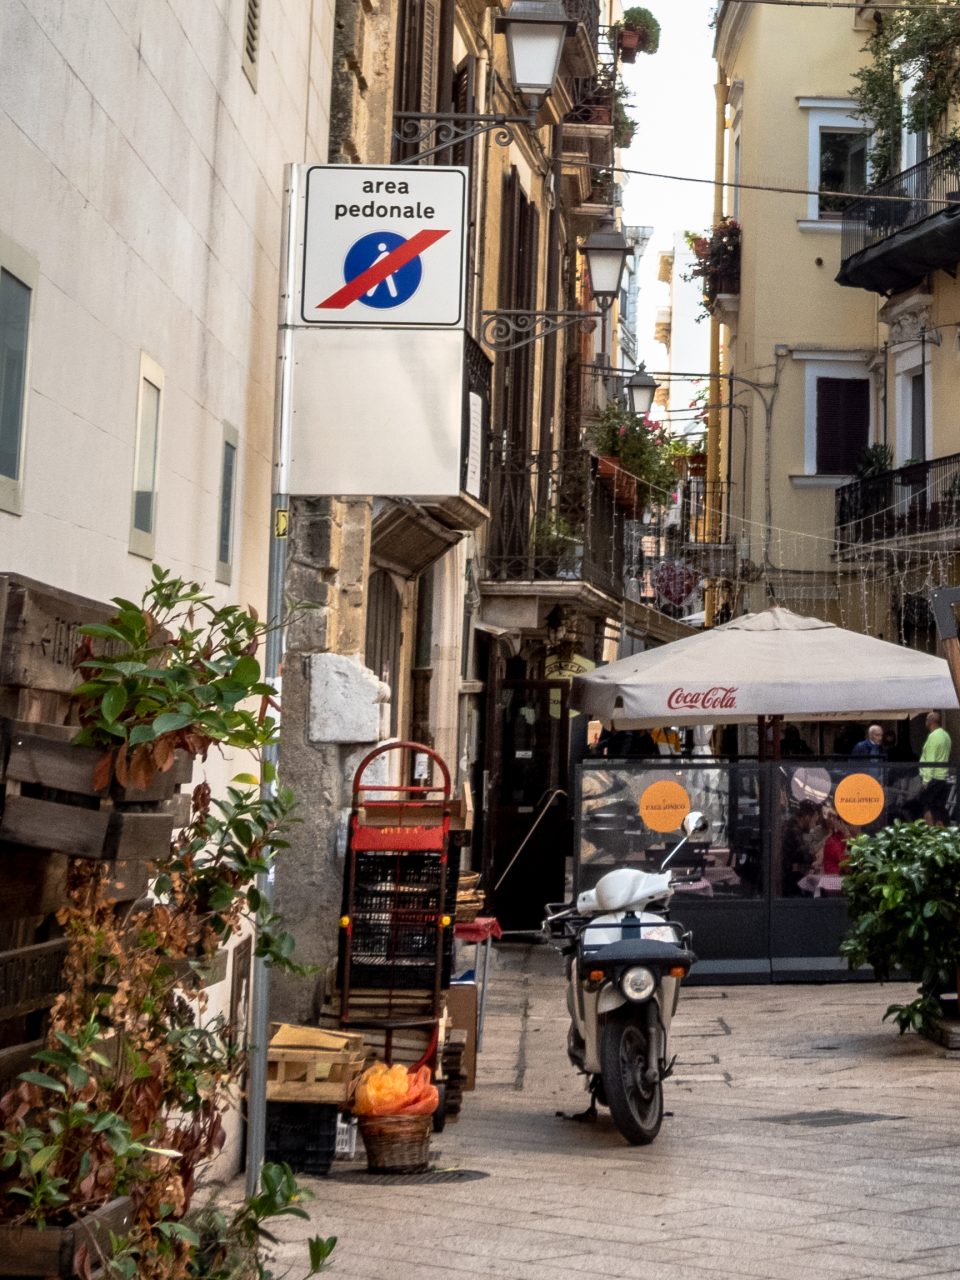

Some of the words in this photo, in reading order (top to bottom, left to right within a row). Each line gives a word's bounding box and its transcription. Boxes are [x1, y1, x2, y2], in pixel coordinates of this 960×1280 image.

[362, 179, 410, 195] area
[334, 201, 436, 220] pedonale
[667, 686, 739, 710] Coca-Cola
